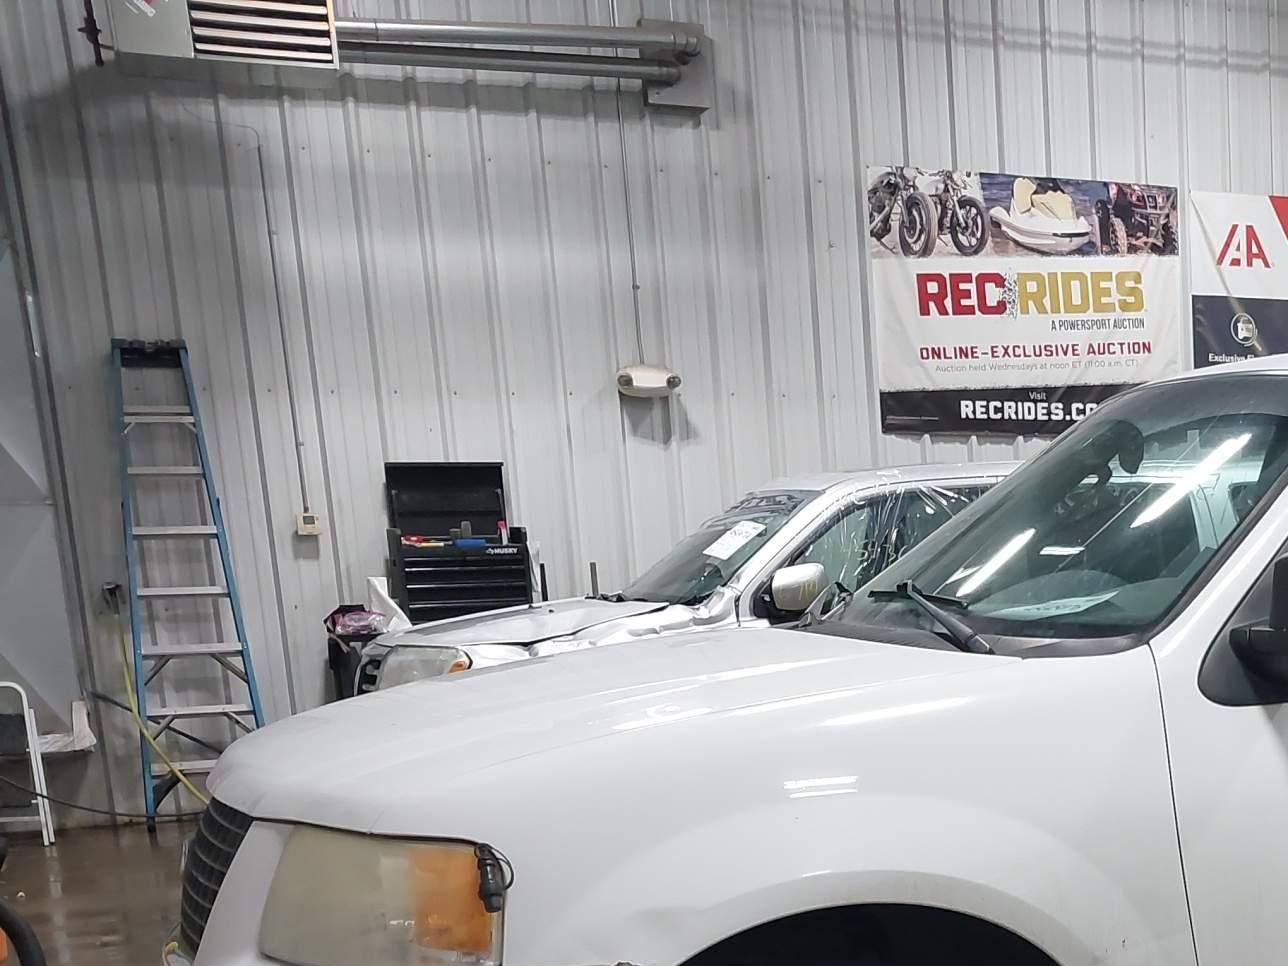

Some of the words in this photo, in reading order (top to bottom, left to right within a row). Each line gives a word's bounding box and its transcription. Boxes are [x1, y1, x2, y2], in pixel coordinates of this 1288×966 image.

[1051, 320, 1057, 331] A
[1058, 318, 1110, 331] POWERSPORT
[1112, 317, 1144, 329] AUCTION
[919, 343, 1081, 360] ONLINE-EXCLUSIVE
[1086, 341, 1152, 355] AUCTION
[1028, 391, 1047, 400] Visit
